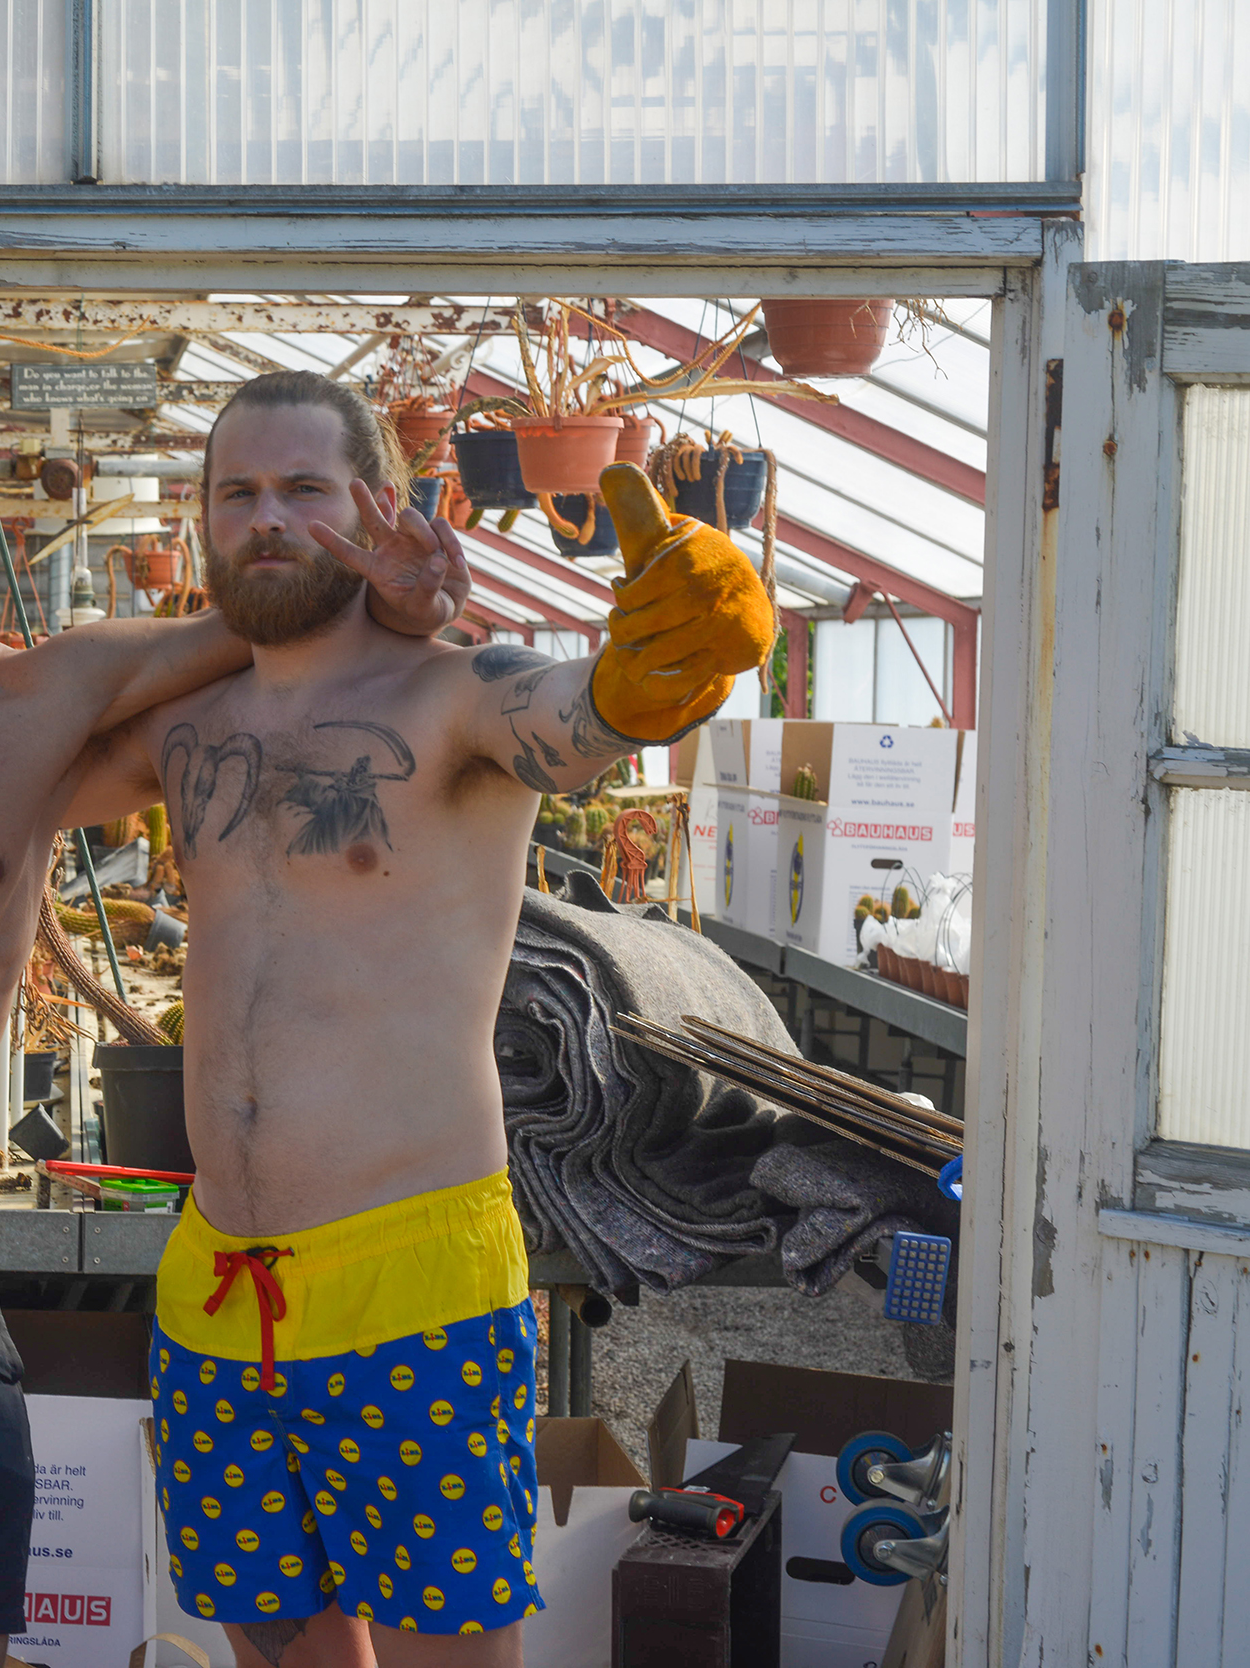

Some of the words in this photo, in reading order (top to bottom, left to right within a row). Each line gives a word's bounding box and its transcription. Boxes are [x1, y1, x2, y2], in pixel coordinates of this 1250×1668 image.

[24, 368, 40, 378] Do
[64, 369, 86, 378] want
[89, 369, 98, 378] to
[102, 367, 118, 378] talk
[121, 369, 130, 378] to
[103, 380, 117, 390] the
[23, 392, 42, 402] who
[45, 392, 73, 402] knows
[846, 823, 932, 840] BAUHAUS
[50, 1464, 62, 1475] är
[65, 1465, 86, 1476] helt
[48, 1510, 64, 1521] till.
